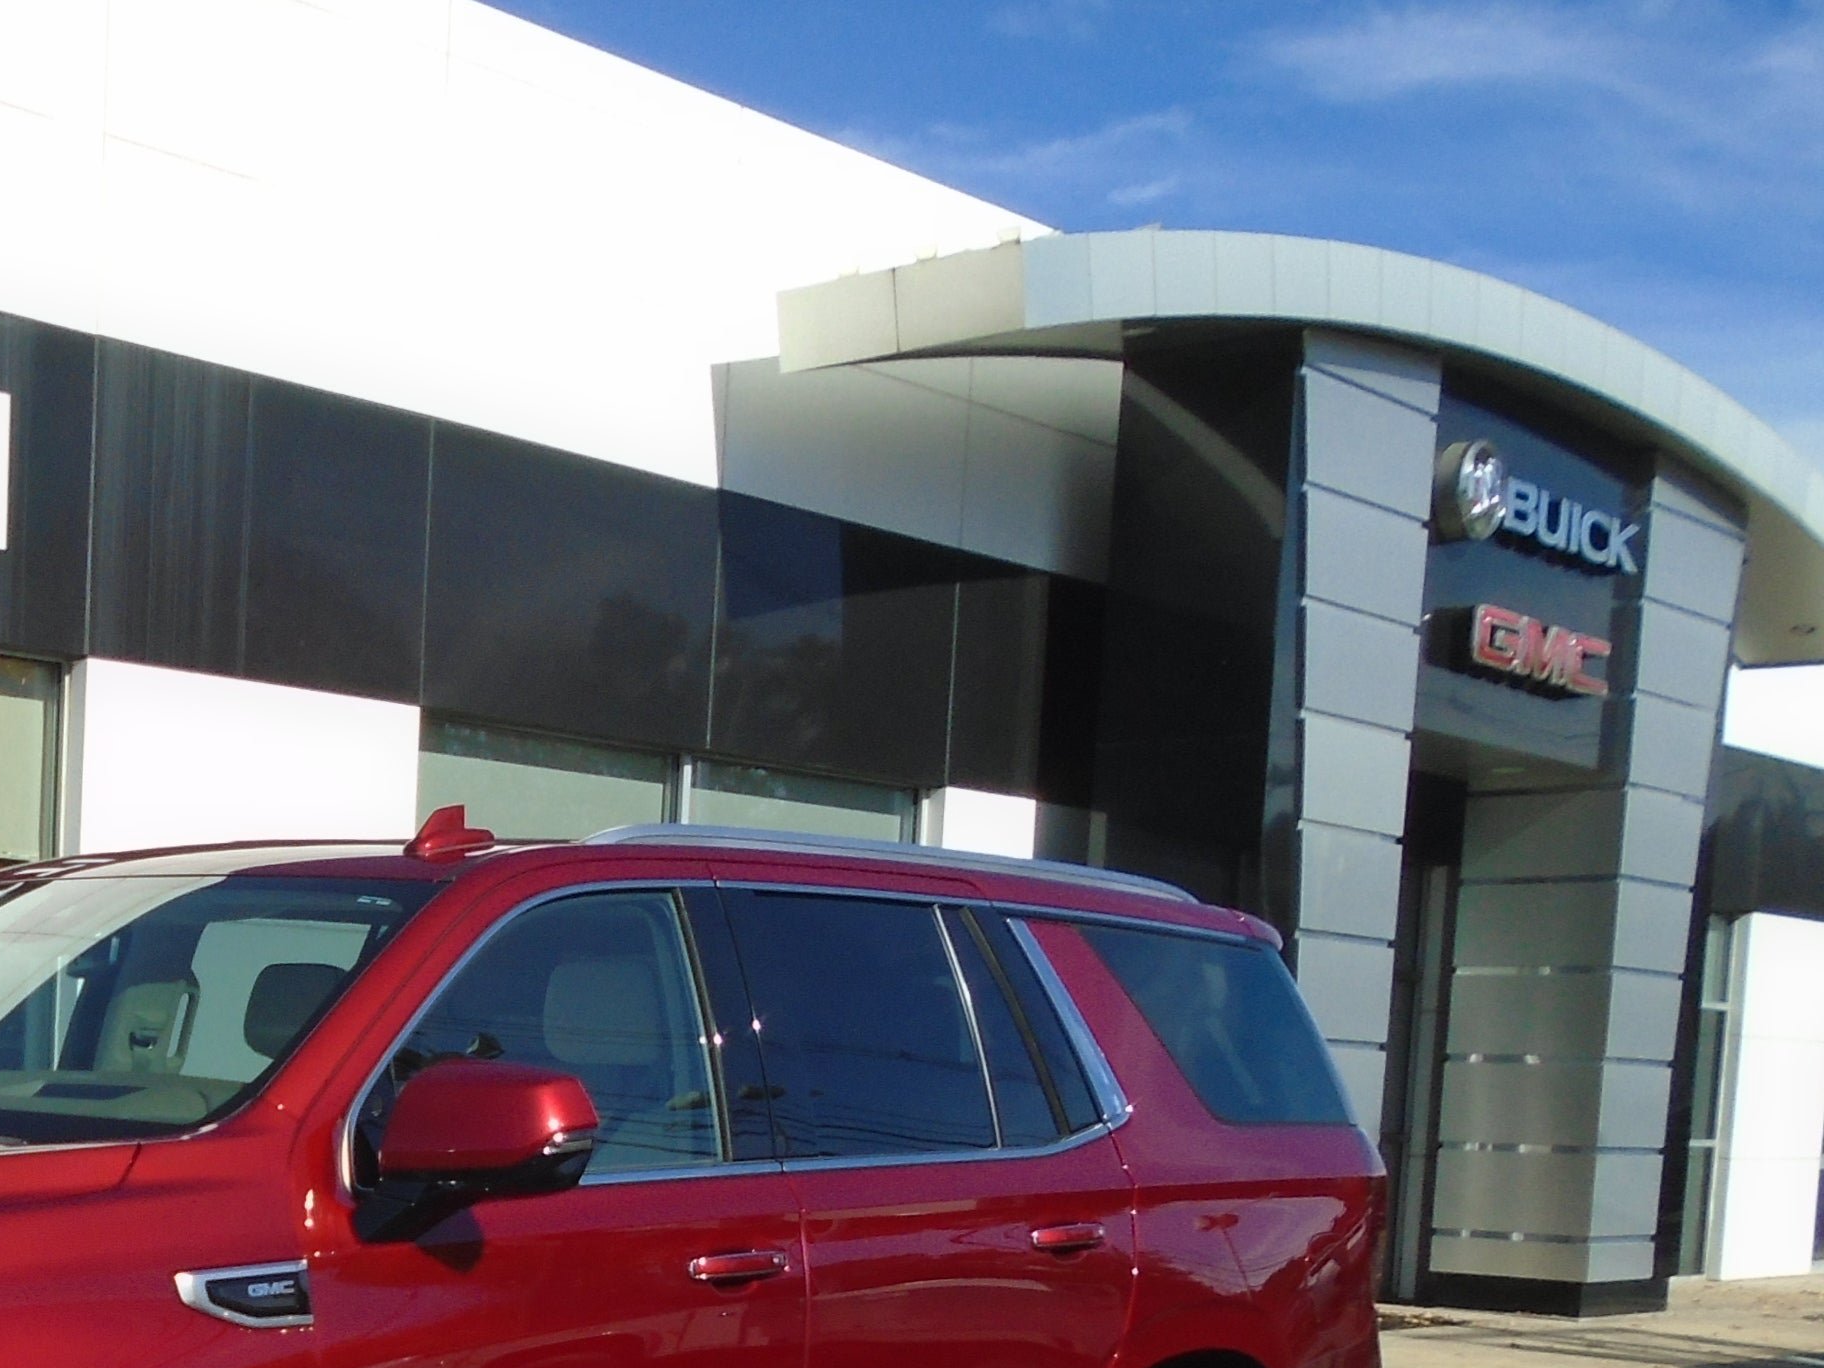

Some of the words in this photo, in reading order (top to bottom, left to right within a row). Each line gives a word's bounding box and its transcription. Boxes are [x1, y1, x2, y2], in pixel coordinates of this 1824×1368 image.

[1501, 475, 1640, 575] BUICK
[1472, 603, 1613, 696] GMC
[247, 1279, 295, 1297] GMC
